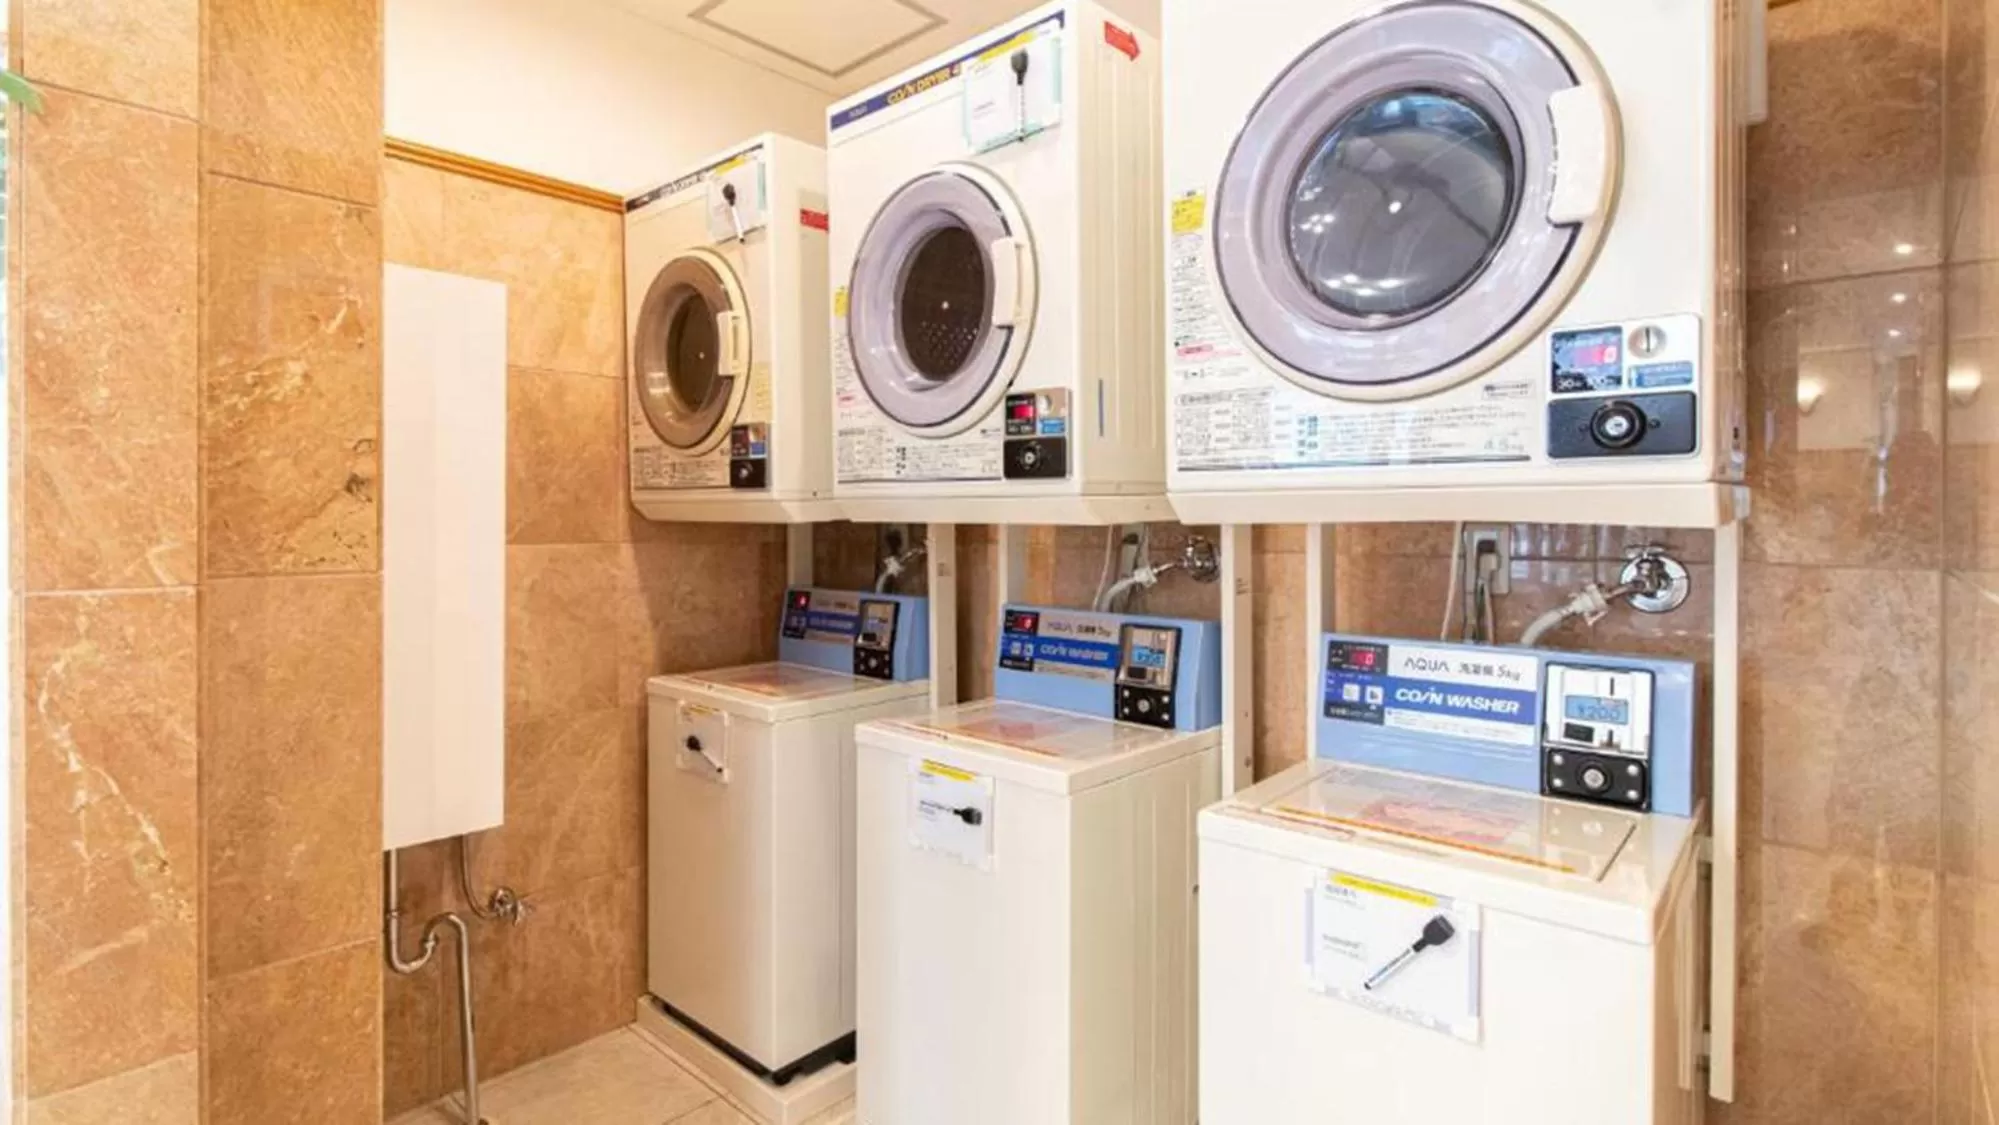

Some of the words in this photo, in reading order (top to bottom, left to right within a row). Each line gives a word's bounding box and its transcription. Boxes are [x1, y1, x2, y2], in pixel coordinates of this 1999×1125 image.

[1404, 656, 1450, 673] AQUA
[1497, 664, 1521, 682] 5kg
[1395, 685, 1444, 706] COIN
[1446, 693, 1521, 715] WASHER
